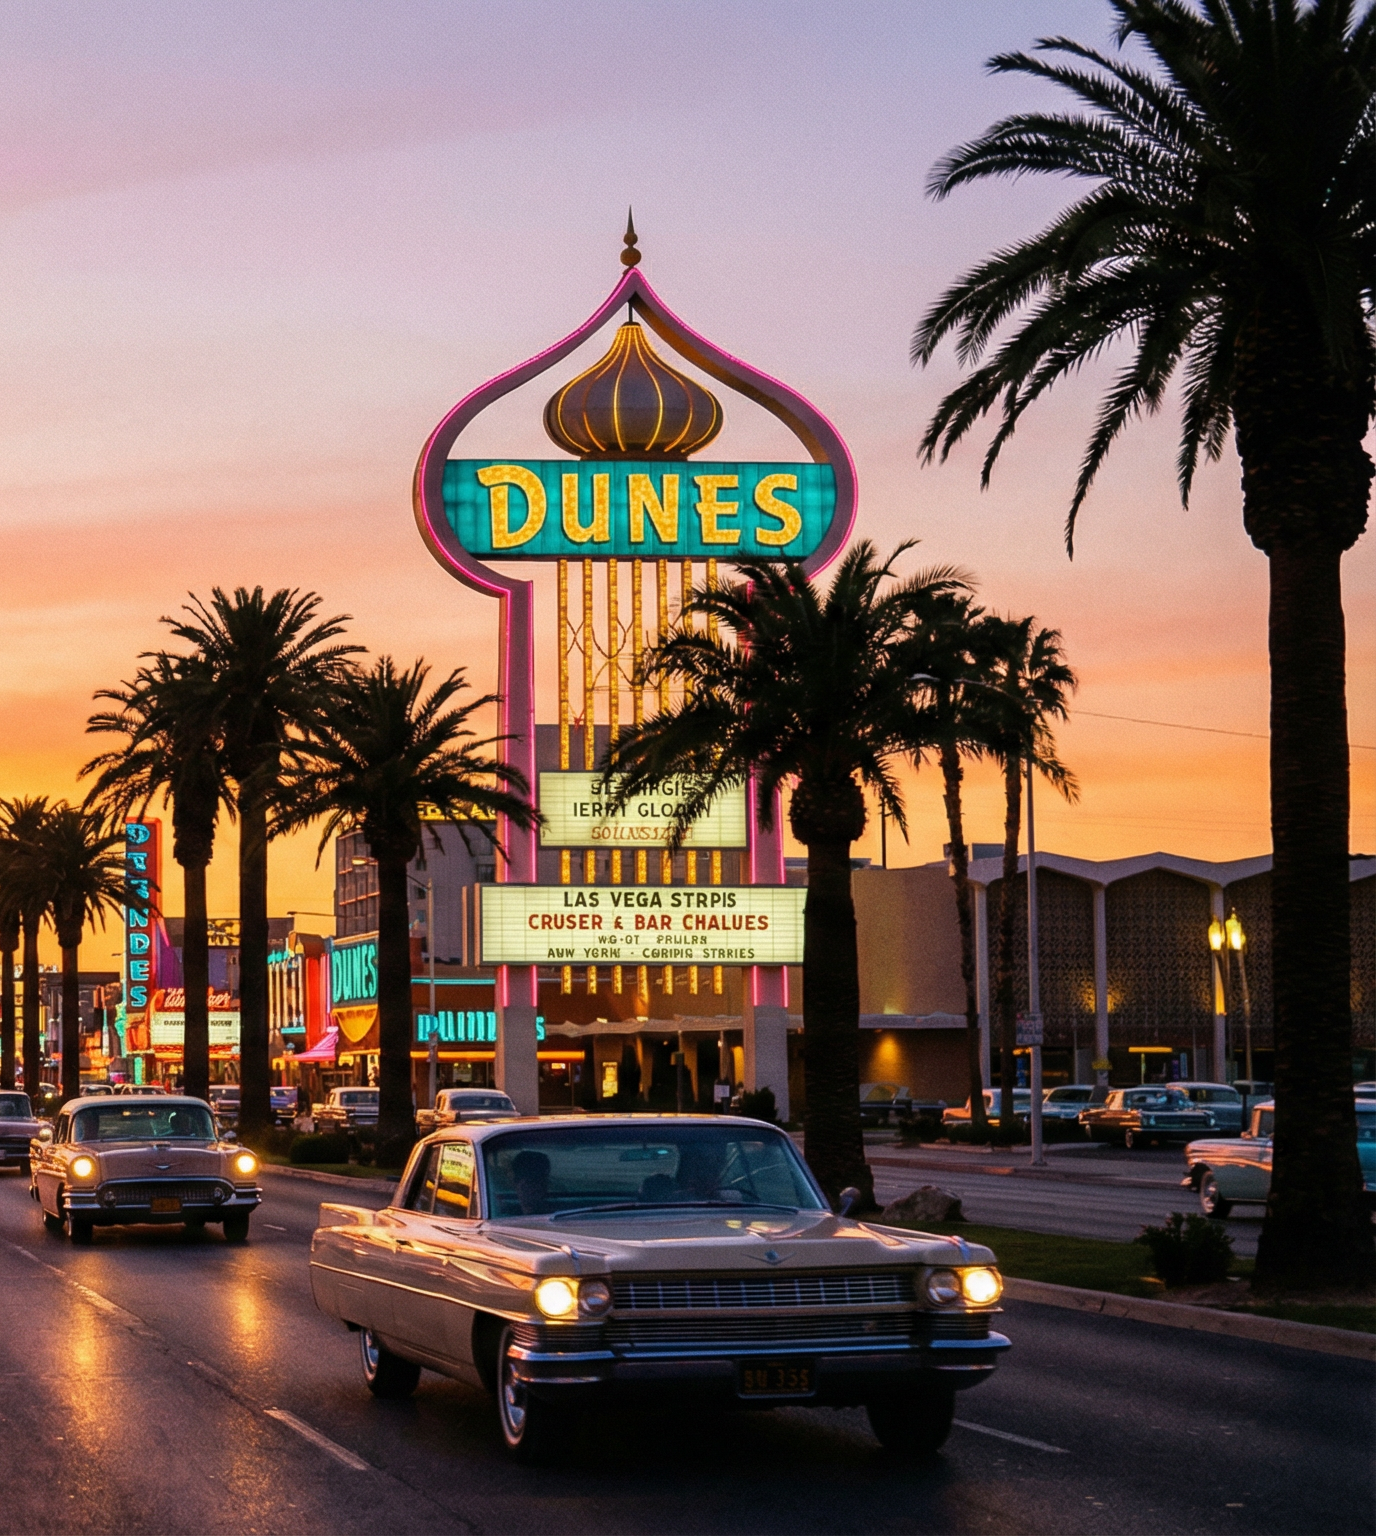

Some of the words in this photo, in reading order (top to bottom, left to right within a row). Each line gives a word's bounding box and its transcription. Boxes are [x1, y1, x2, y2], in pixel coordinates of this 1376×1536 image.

[477, 464, 803, 549] DUNES
[563, 891, 599, 908] LAS
[610, 891, 663, 909] VEGA
[528, 914, 603, 930] CRUSER
[635, 914, 672, 930] BAR
[682, 914, 769, 931] CHALUES
[332, 944, 377, 1003] DUNES
